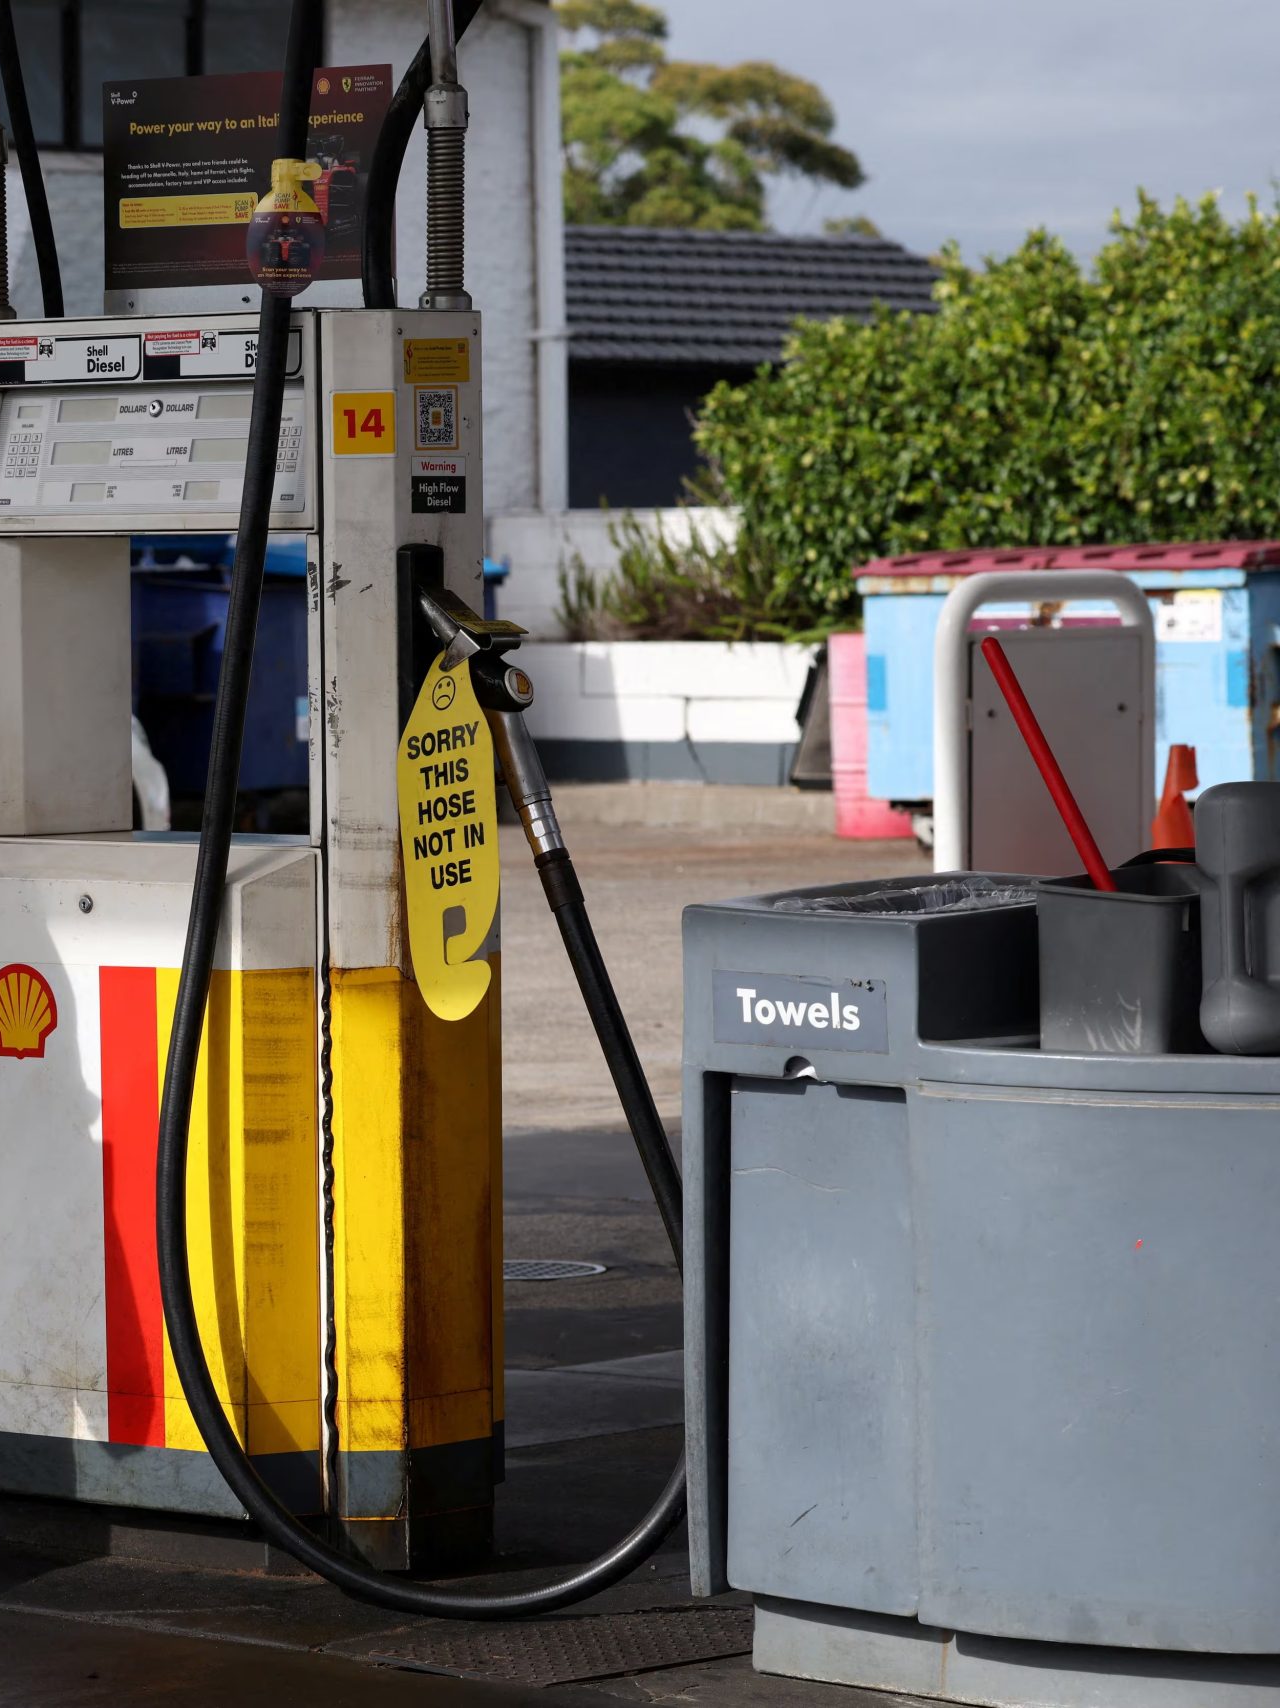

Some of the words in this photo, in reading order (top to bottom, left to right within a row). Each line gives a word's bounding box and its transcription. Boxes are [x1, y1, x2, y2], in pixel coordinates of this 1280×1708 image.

[130, 122, 165, 135] Power
[168, 122, 194, 136] your
[196, 120, 222, 134] way
[225, 118, 237, 130] to
[240, 118, 255, 128] an
[258, 113, 280, 128] Itali
[308, 110, 364, 128] xperience
[87, 344, 108, 357] Shell
[87, 356, 125, 373] Diesel
[119, 405, 147, 414] DOLLARS
[166, 404, 194, 412] DOLLARS
[344, 408, 385, 438] 14
[113, 448, 134, 456] LITRES
[166, 446, 187, 455] LITRES
[421, 460, 456, 474] Warning
[419, 483, 438, 496] High
[439, 482, 459, 493] Flow
[427, 496, 451, 506] Diesel
[407, 721, 480, 760] SORRY
[420, 758, 469, 790] THIS
[418, 790, 476, 826] HOSE
[414, 829, 455, 862] NOT
[464, 822, 485, 849] IN
[431, 859, 472, 890] USE
[736, 987, 861, 1031] Towels
